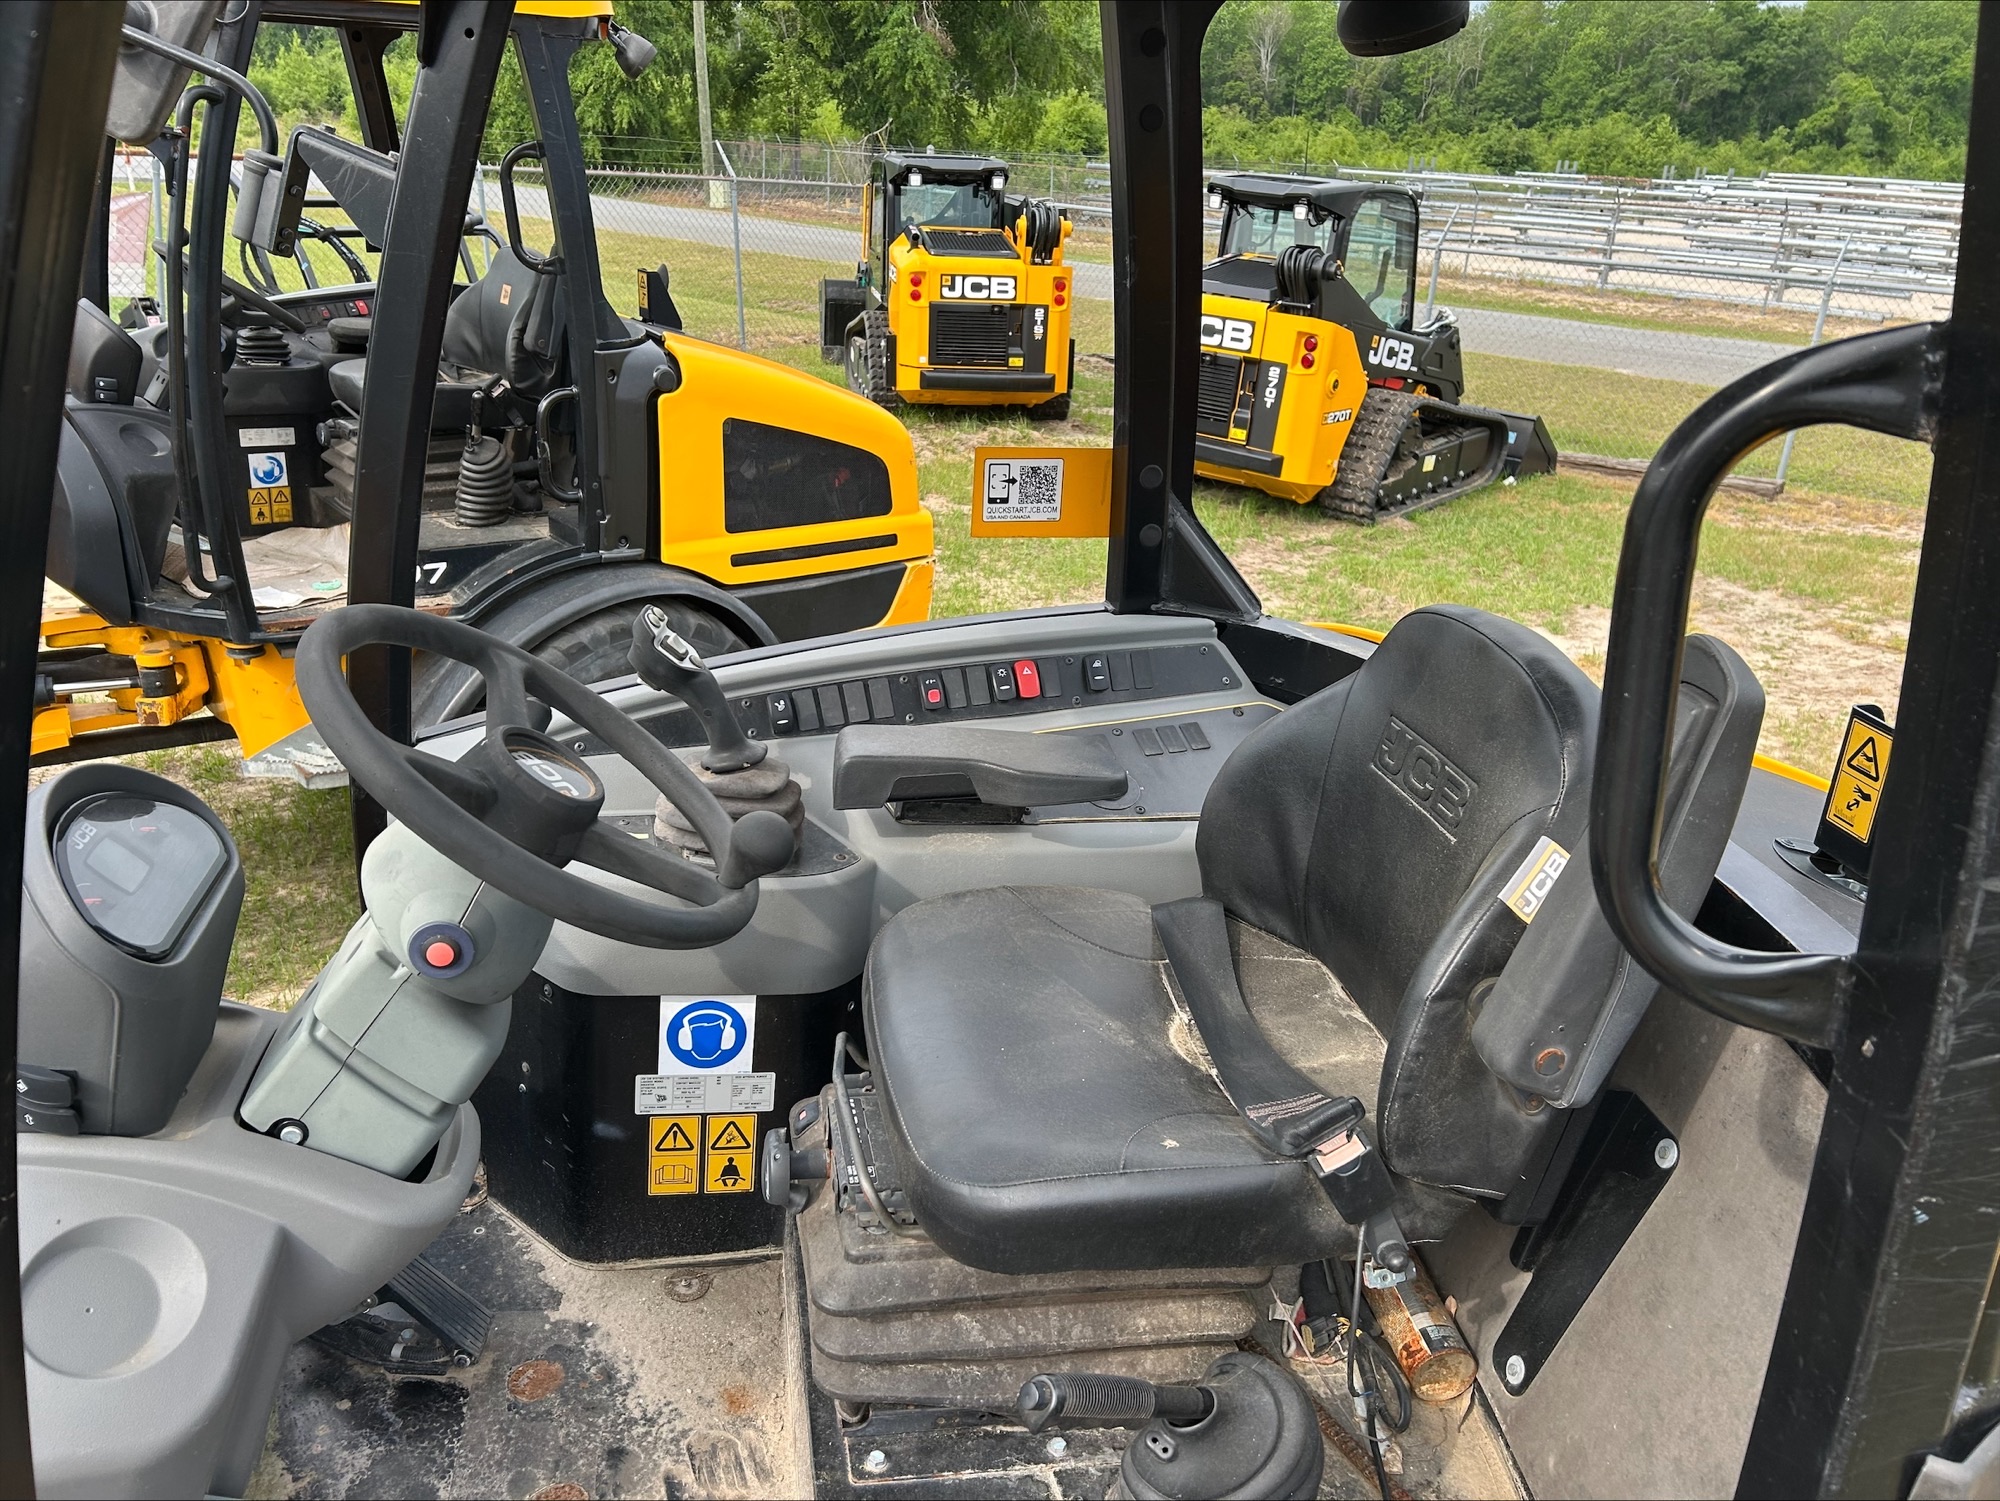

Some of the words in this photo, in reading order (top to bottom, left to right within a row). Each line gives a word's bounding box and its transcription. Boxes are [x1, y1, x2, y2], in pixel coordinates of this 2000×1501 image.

[941, 276, 1016, 300] JCB
[1200, 316, 1254, 351] CB
[1368, 337, 1415, 371] JCB
[1264, 366, 1281, 409] 270T
[986, 506, 1058, 514] QUICKSTART.JCB.COM
[510, 751, 580, 797] JCB
[1377, 721, 1470, 829] JCB
[72, 823, 97, 850] JCB
[1521, 851, 1568, 915] JCB
